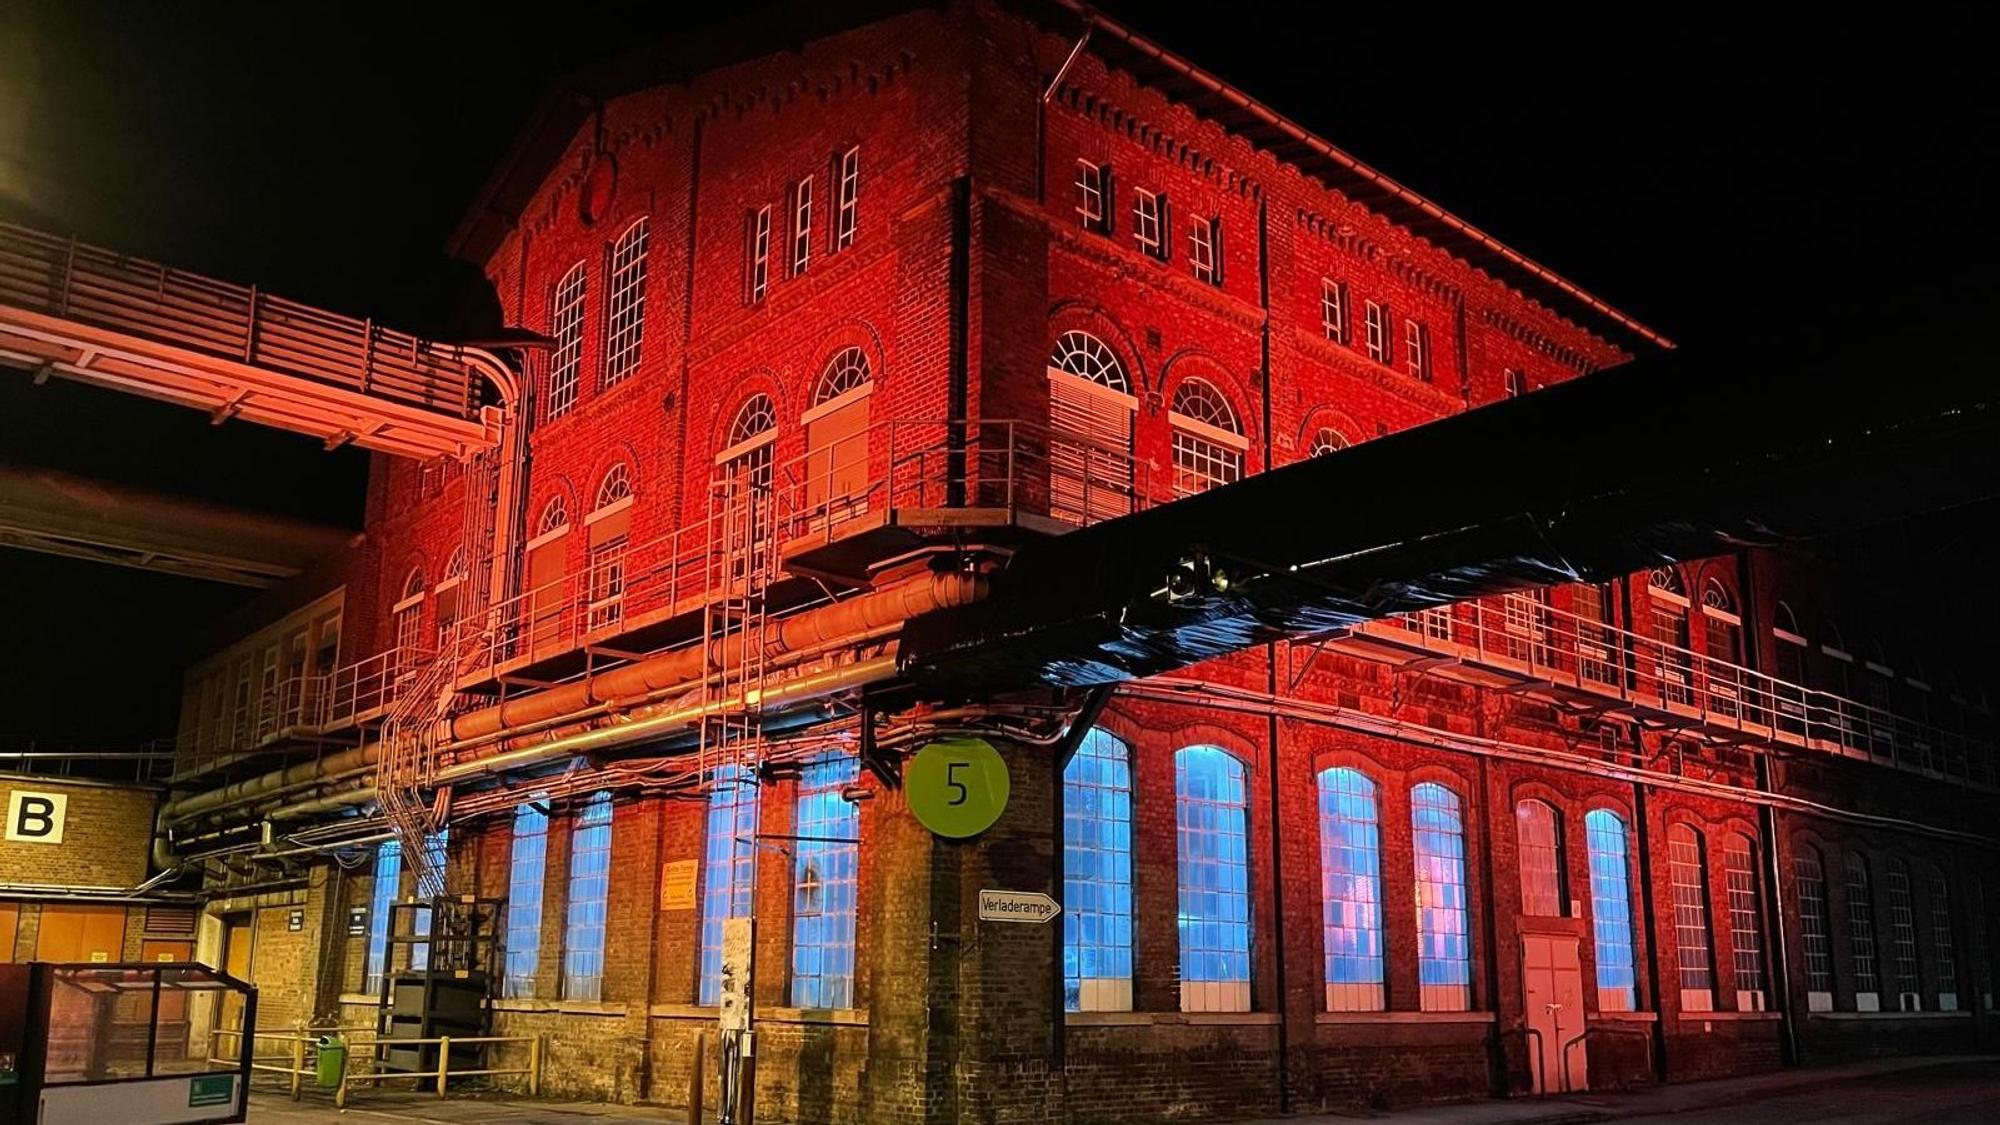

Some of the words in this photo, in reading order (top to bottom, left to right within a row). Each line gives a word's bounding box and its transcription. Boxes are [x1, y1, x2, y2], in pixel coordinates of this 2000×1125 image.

[948, 763, 970, 806] 5
[17, 796, 55, 837] B
[982, 897, 1052, 917] Verladerampe
